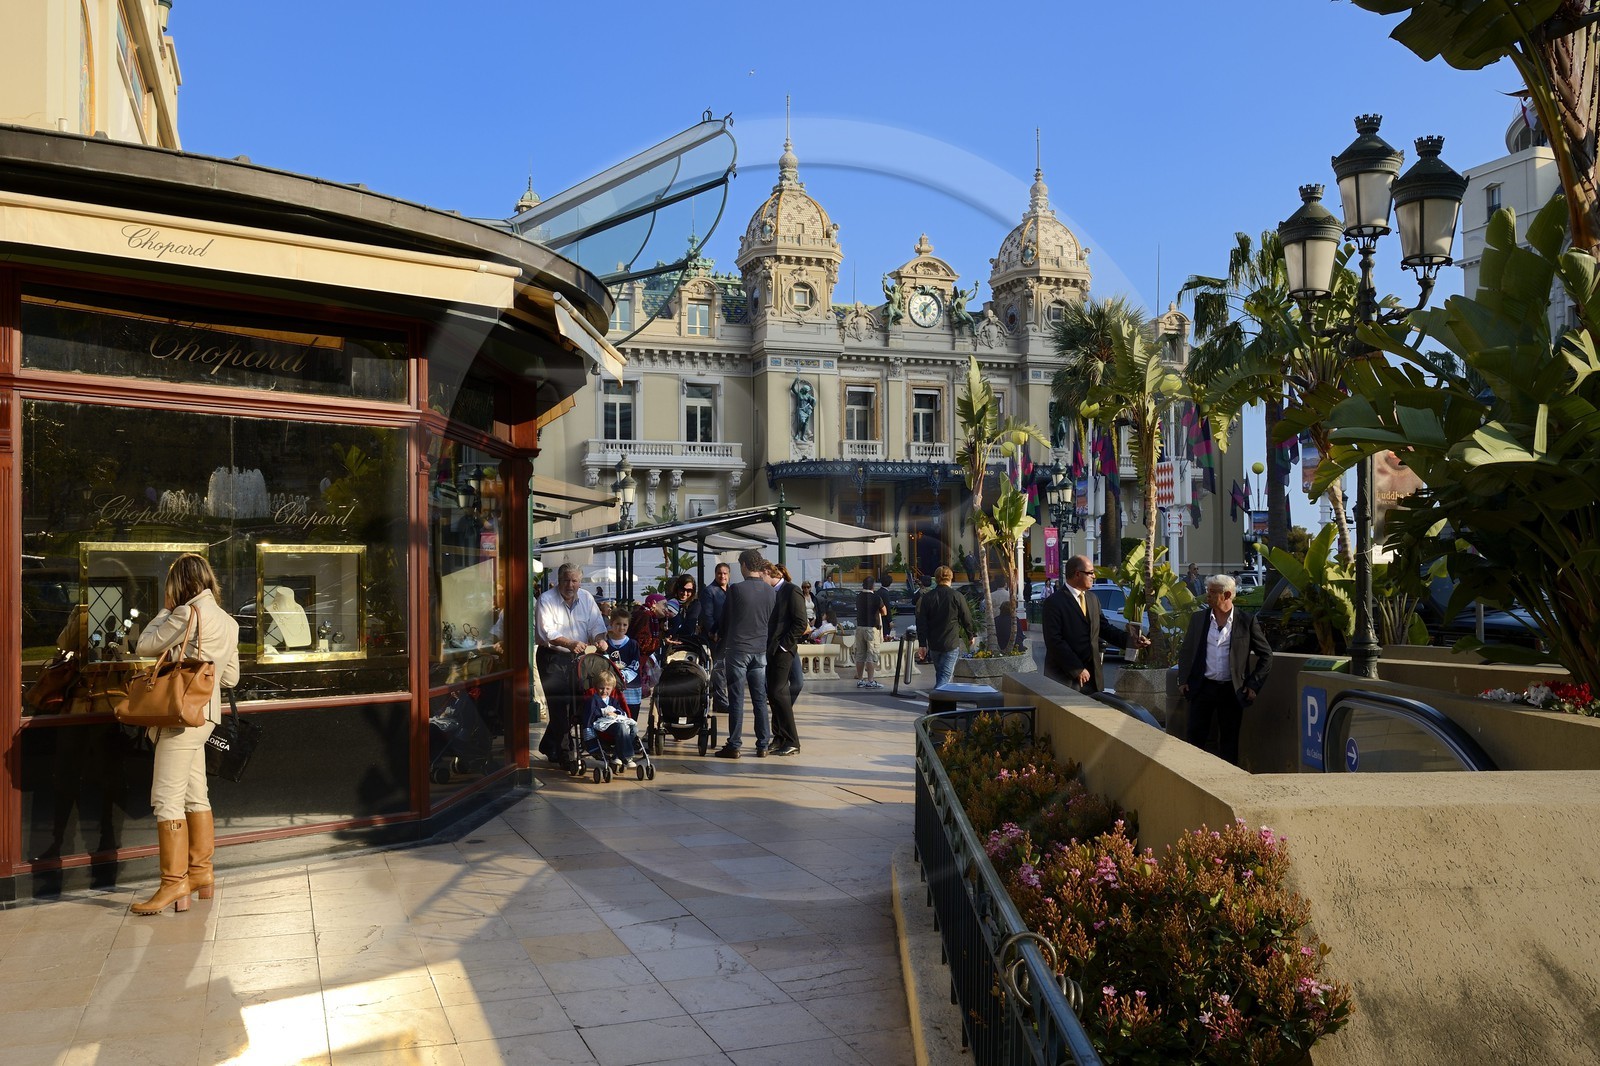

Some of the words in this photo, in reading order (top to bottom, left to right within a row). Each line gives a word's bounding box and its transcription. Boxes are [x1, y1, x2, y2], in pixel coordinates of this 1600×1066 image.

[121, 224, 215, 258] Chopard
[145, 318, 319, 375] Chopard
[93, 493, 189, 526] Chopard
[271, 500, 356, 530] Chopard
[1307, 695, 1319, 737] P
